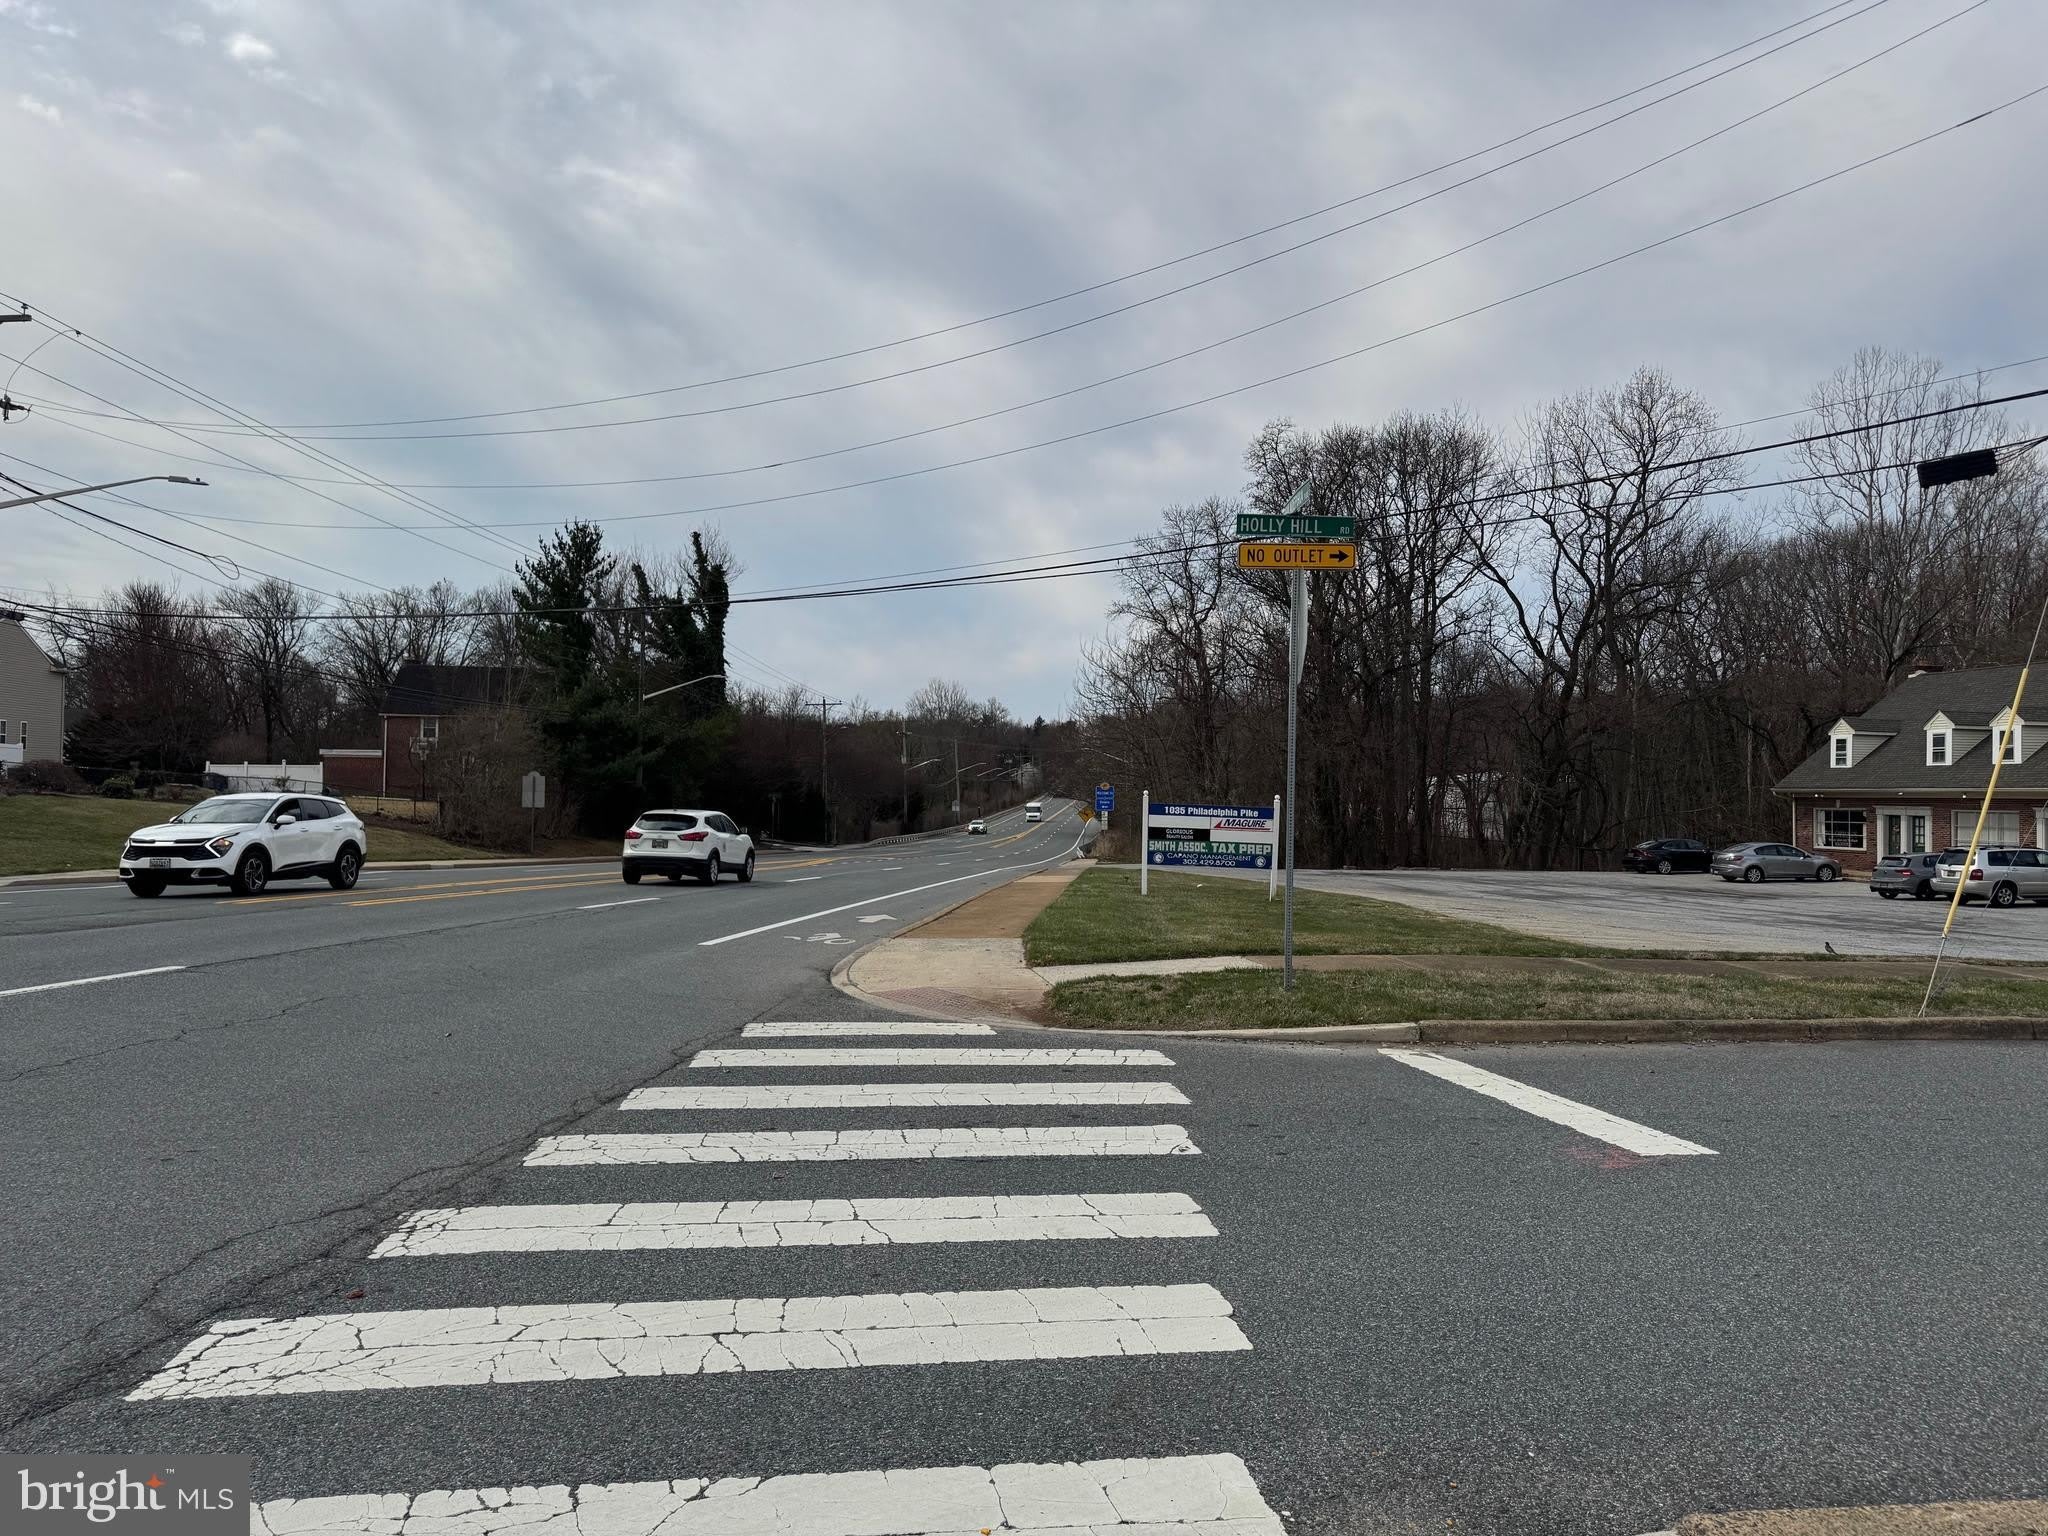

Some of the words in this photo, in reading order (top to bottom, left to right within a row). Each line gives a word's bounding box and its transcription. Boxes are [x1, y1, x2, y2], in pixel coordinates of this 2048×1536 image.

[1240, 517, 1285, 533] HOLLY
[1291, 518, 1322, 534] HILL
[1340, 526, 1350, 535] RD
[1247, 548, 1265, 563] NO
[1274, 548, 1325, 563] OUTLET
[1164, 806, 1186, 815] 1035
[1188, 806, 1238, 817] Philadelphia
[1240, 809, 1259, 818] Pike
[1223, 818, 1267, 828] MAGUIRE
[1149, 840, 1176, 851] SMITH
[1177, 841, 1208, 852] ASSOC.
[1211, 842, 1236, 854] TAX
[1239, 843, 1271, 855] PREP
[1166, 852, 1198, 860] CAPANO
